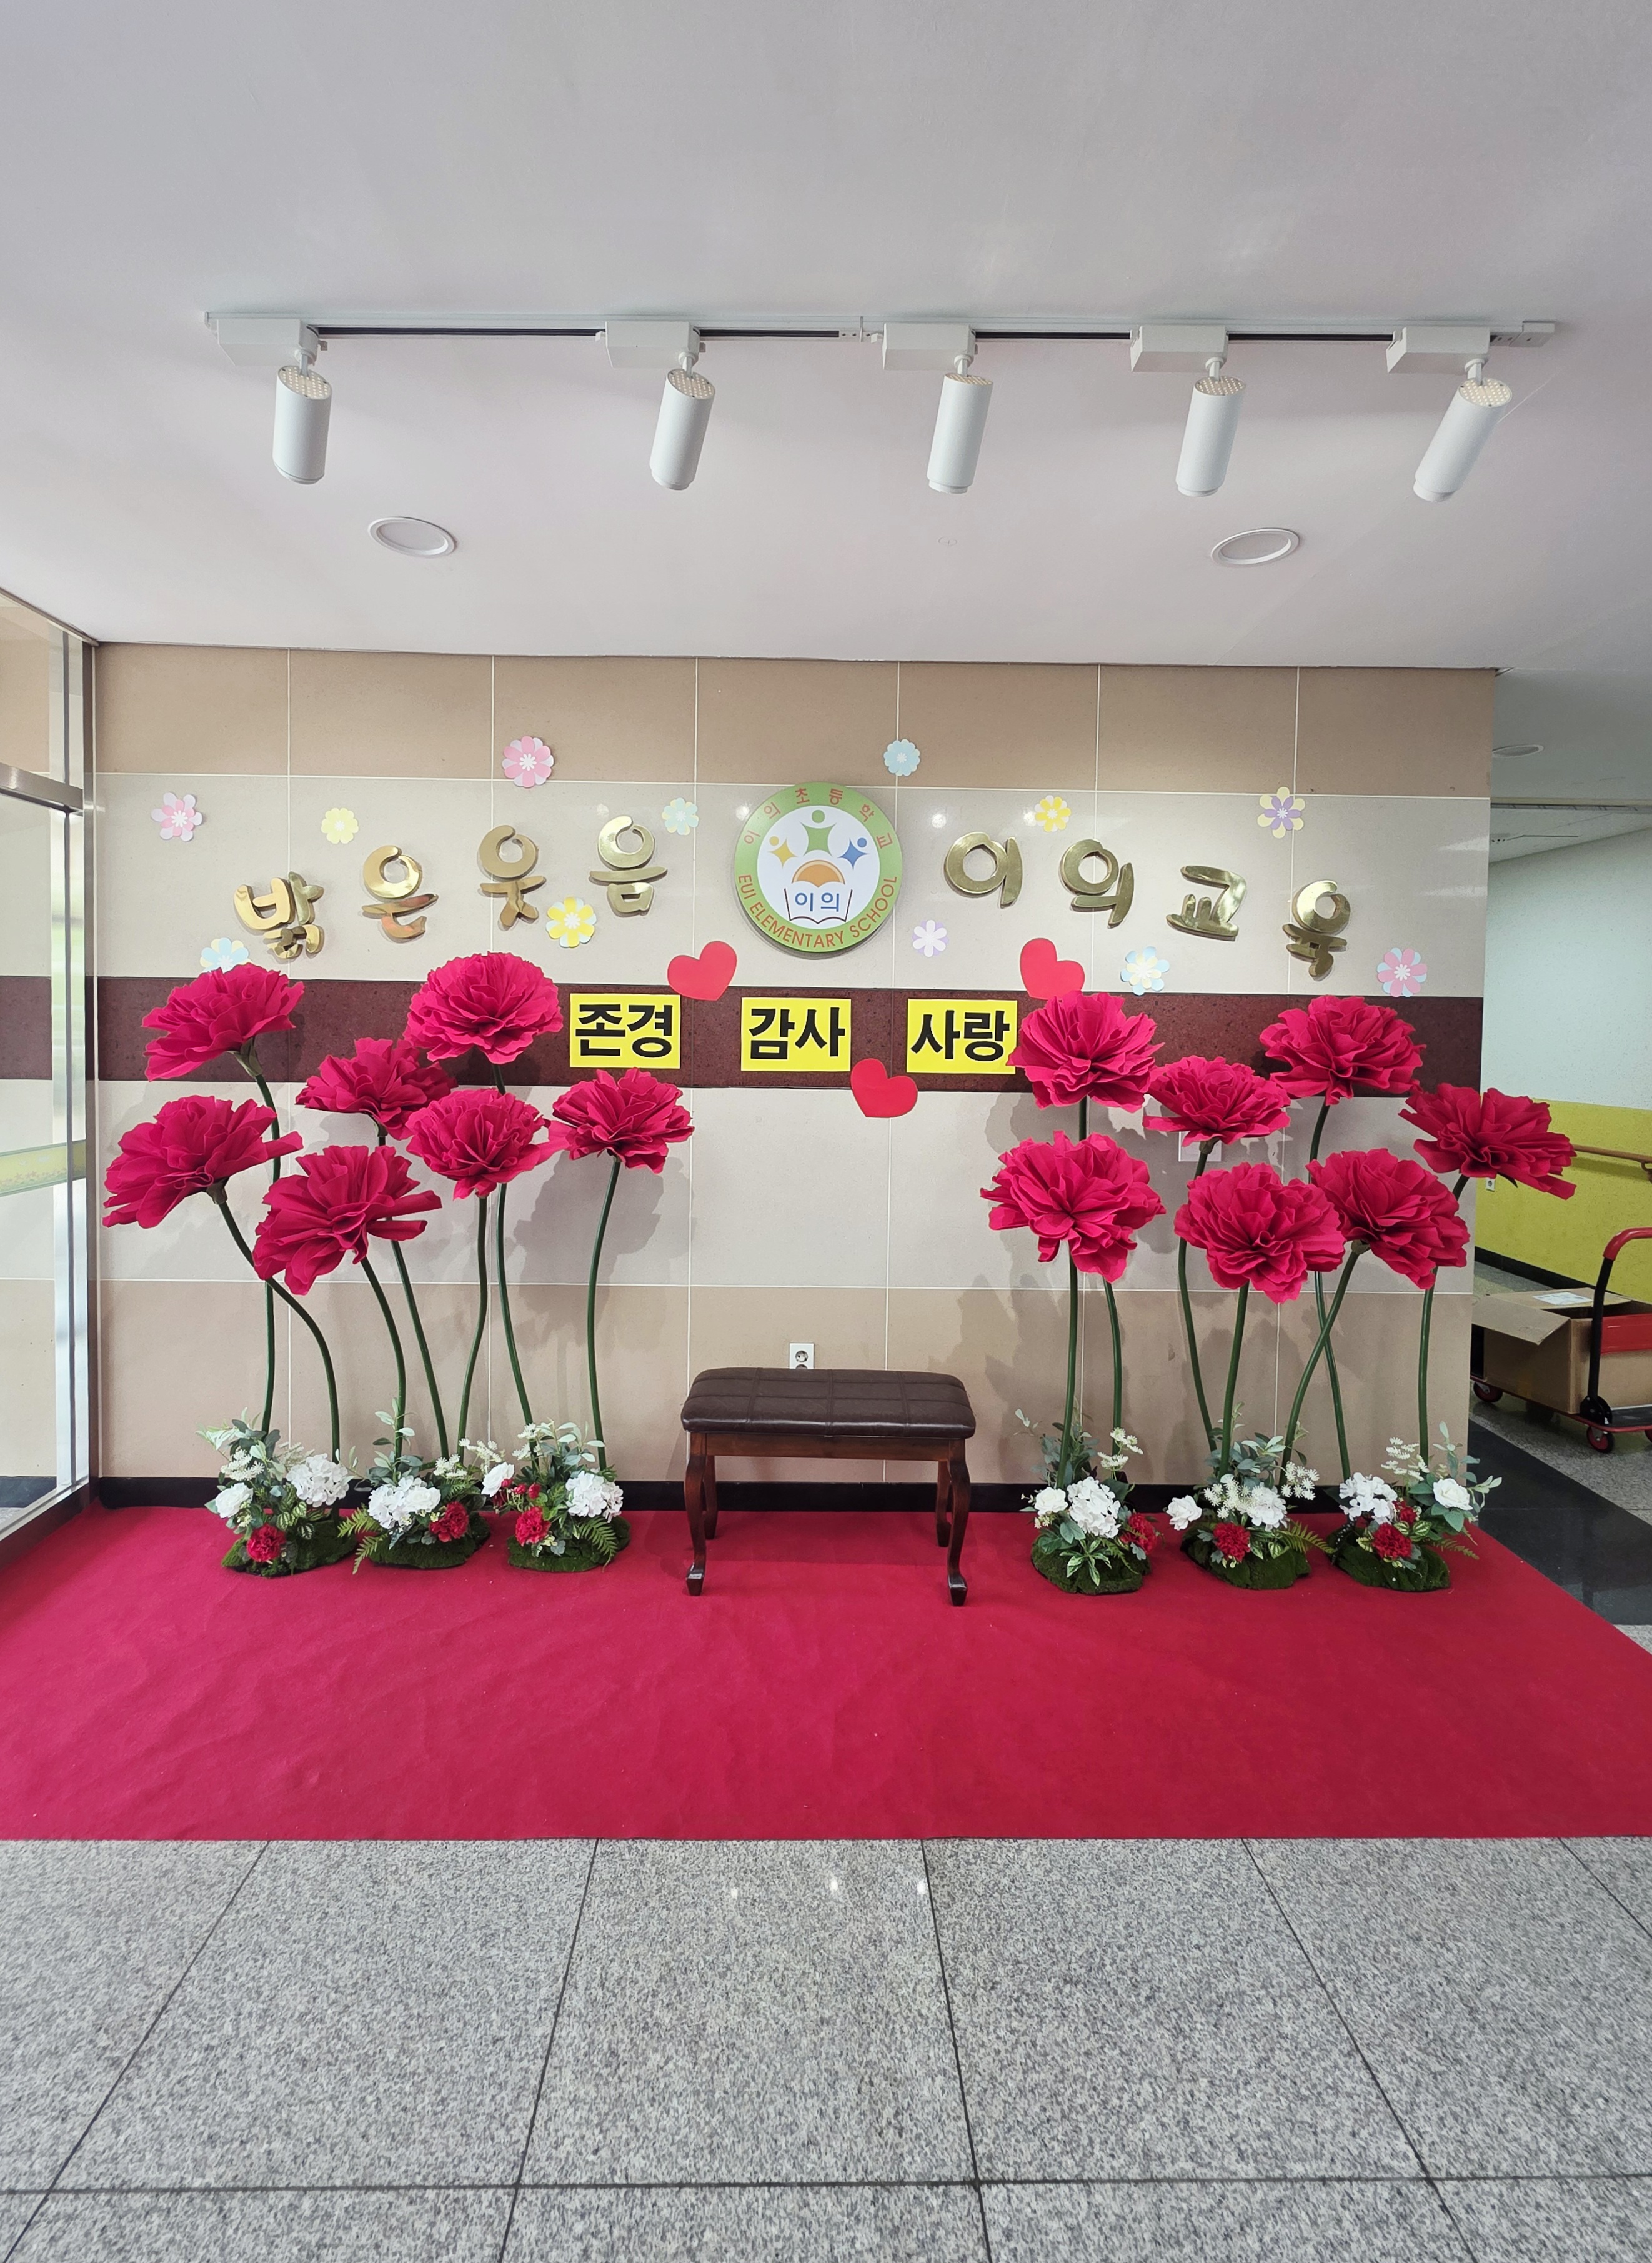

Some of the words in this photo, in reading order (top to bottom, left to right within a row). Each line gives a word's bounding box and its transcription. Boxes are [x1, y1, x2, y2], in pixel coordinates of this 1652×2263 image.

[744, 787, 893, 849] 이의초등학교
[234, 845, 439, 959] 밝은
[479, 815, 667, 927] 웃음
[738, 874, 757, 899] EUI
[750, 901, 844, 948] ELEMENTARY
[850, 876, 897, 937] SCHOOL
[795, 892, 840, 912] 이의
[575, 1003, 673, 1057] 존경
[749, 1007, 846, 1059] 감사
[911, 1009, 1011, 1062] 사랑
